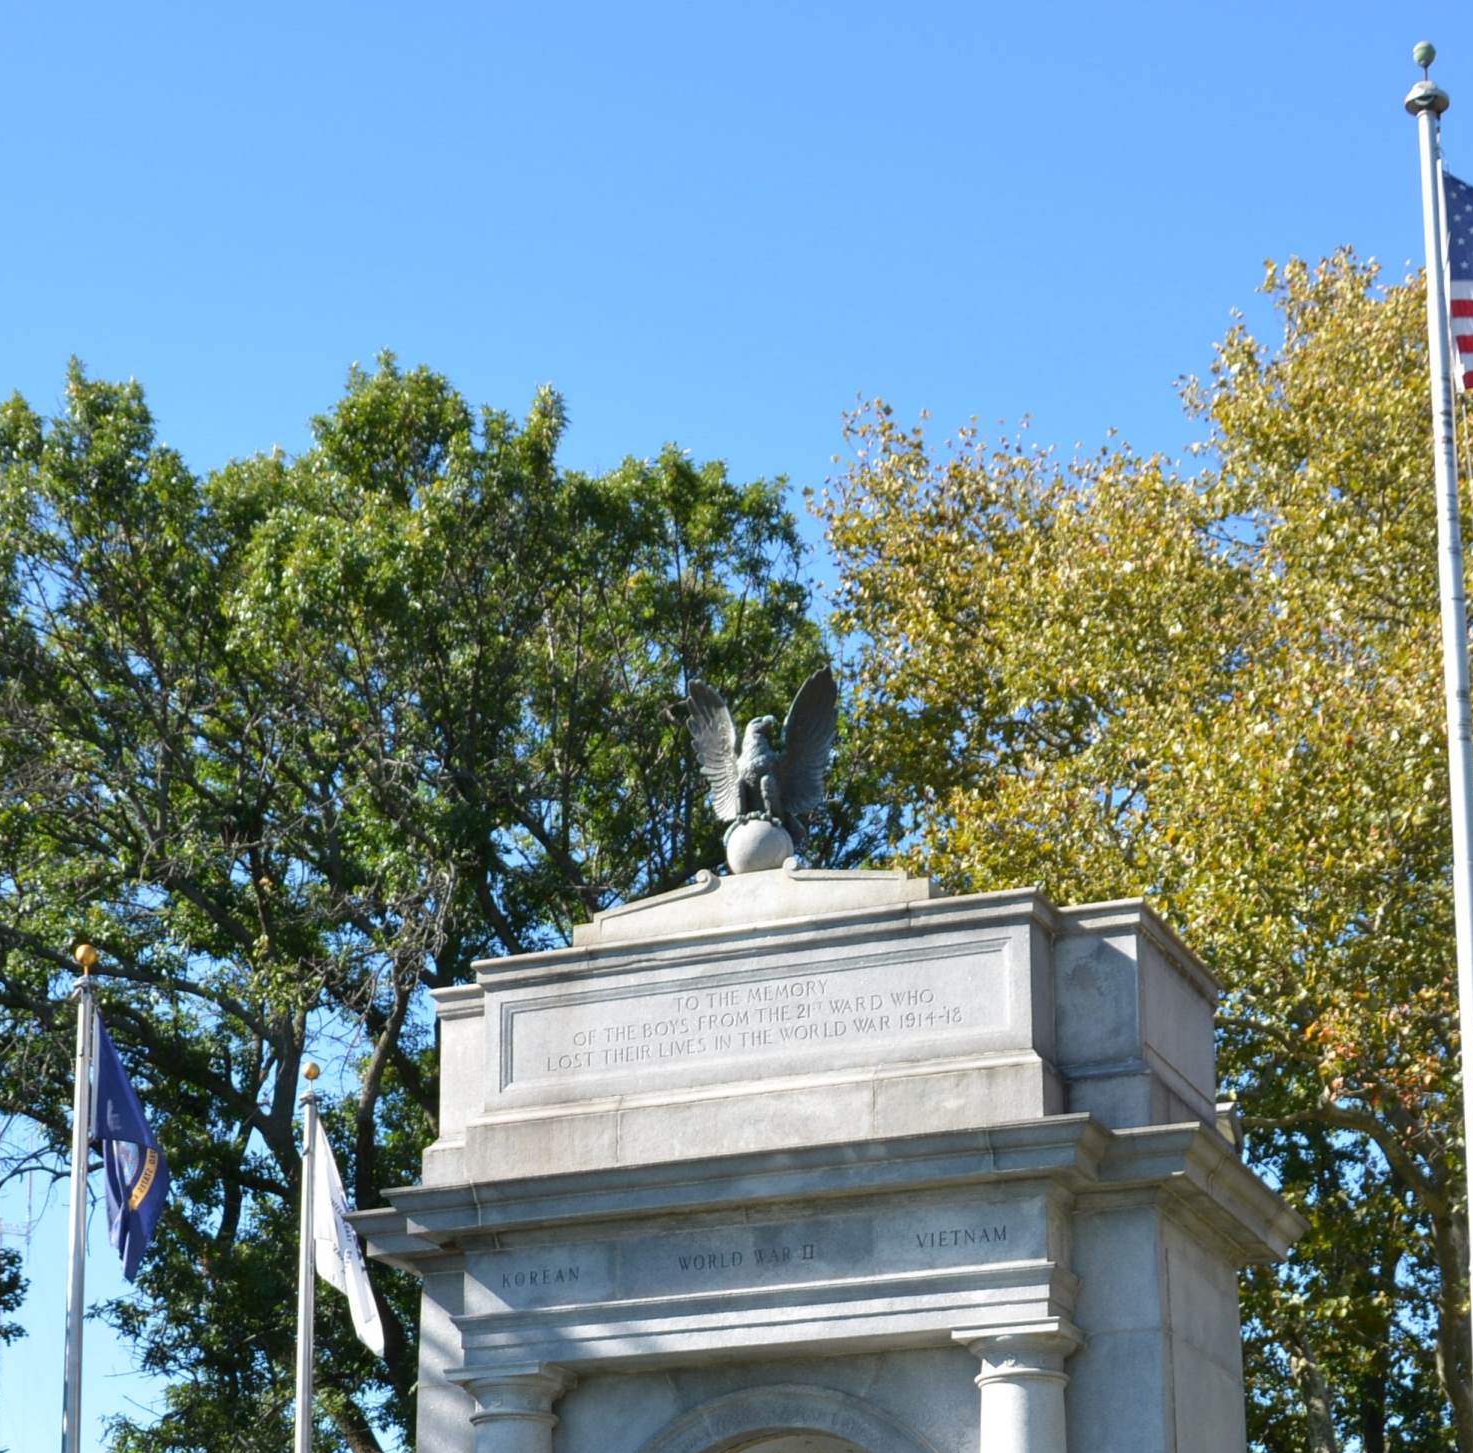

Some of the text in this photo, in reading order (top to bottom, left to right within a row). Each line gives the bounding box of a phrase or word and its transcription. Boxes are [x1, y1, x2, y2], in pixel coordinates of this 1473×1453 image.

[676, 979, 829, 1013] TO THE MEMORY
[573, 1030, 596, 1046] OF
[604, 1025, 637, 1043] THE
[643, 1018, 690, 1039] BOYS
[698, 1010, 749, 1030] FROM
[758, 1005, 791, 1023] THE
[830, 994, 883, 1014] WARD
[890, 988, 934, 1007] WHO
[547, 1051, 594, 1072] LOST
[604, 1044, 651, 1064] THEIR
[658, 1038, 707, 1058] LIVES
[714, 1035, 731, 1051] IN
[740, 1029, 774, 1049] THE
[779, 1020, 847, 1042] WORLD
[853, 1015, 891, 1034] WAR
[916, 1225, 1008, 1249] VIETNAM
[678, 1250, 744, 1272] WORLD
[754, 1248, 792, 1265] WAR
[502, 1267, 580, 1289] KOREAN
